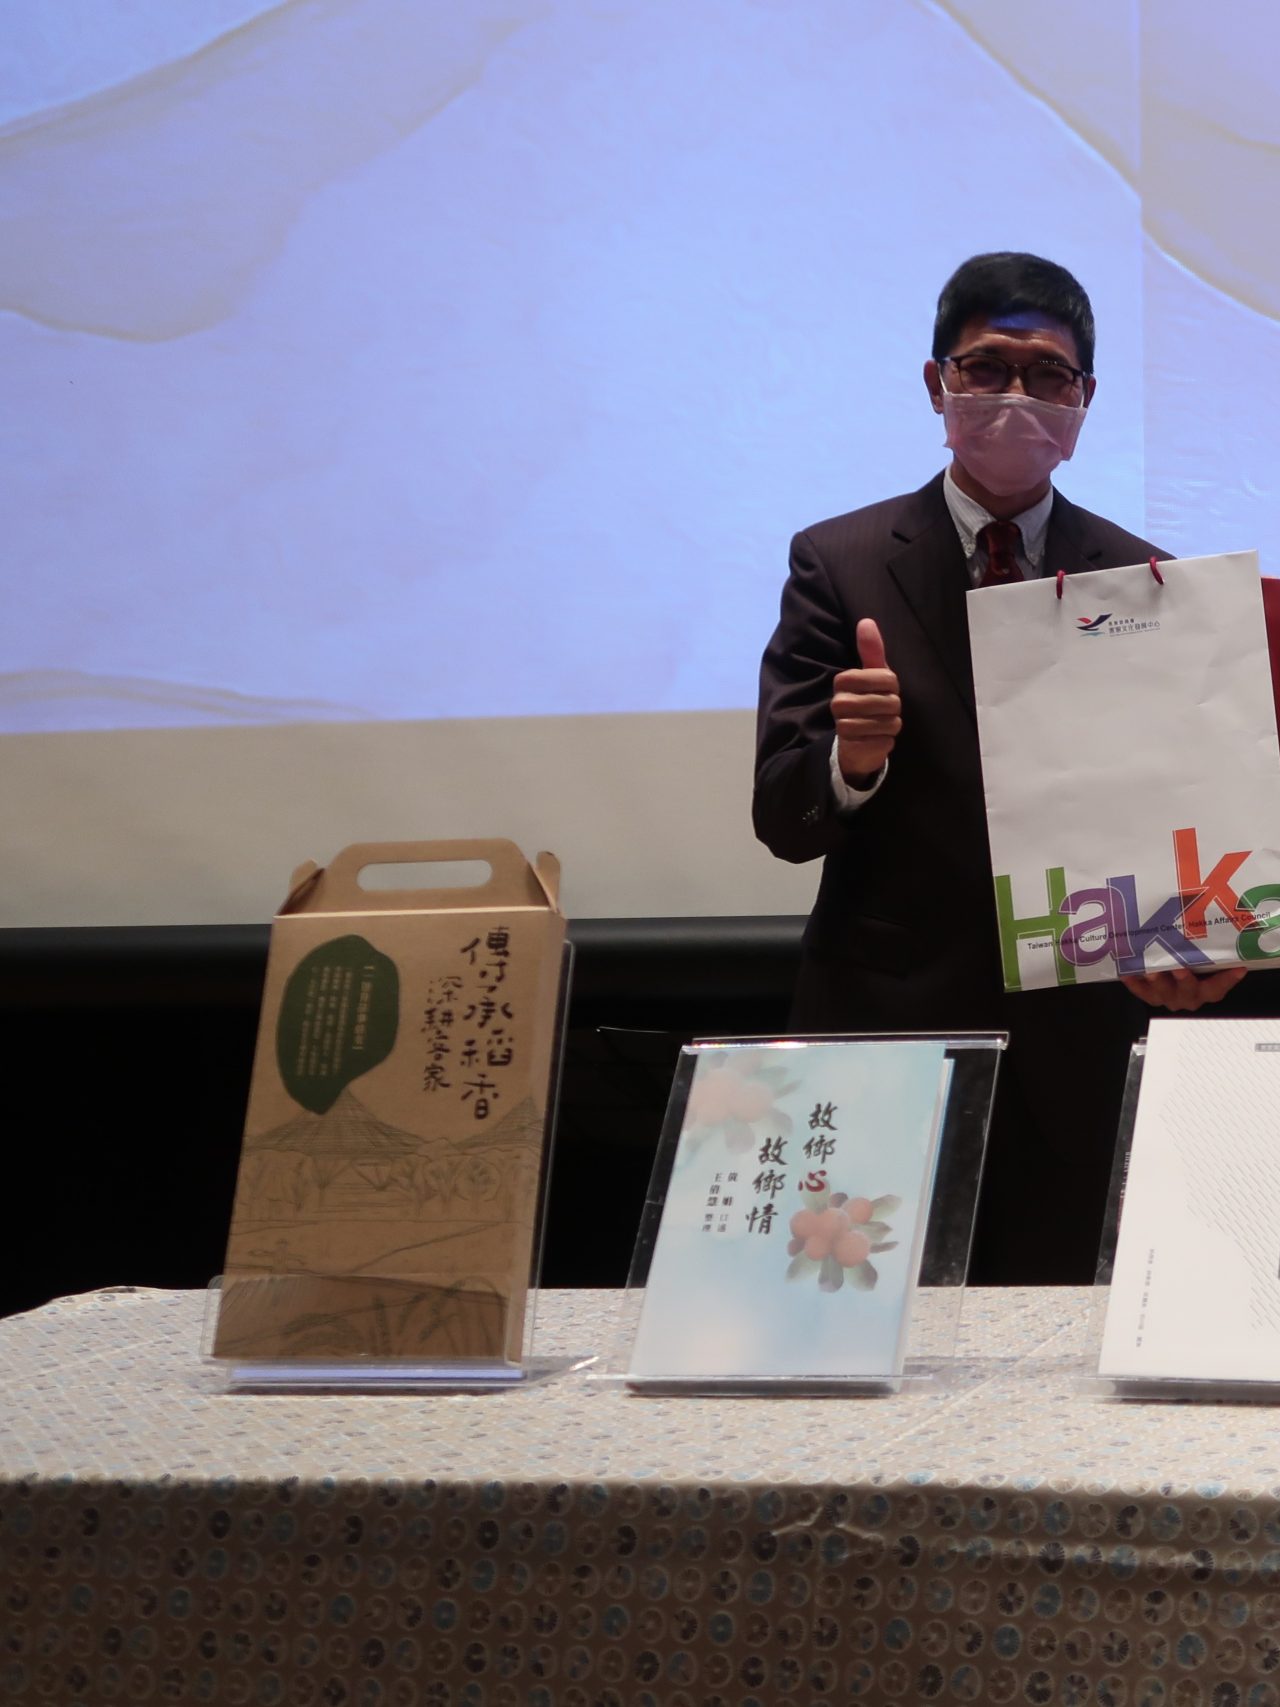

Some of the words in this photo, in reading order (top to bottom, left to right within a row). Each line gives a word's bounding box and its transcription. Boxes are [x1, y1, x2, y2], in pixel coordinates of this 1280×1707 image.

[1027, 939, 1053, 951] Taiwan
[1079, 932, 1107, 943] Culture
[1240, 910, 1271, 922] Council
[745, 1136, 788, 1235] 故鄉情
[797, 1101, 838, 1193] 故鄉心
